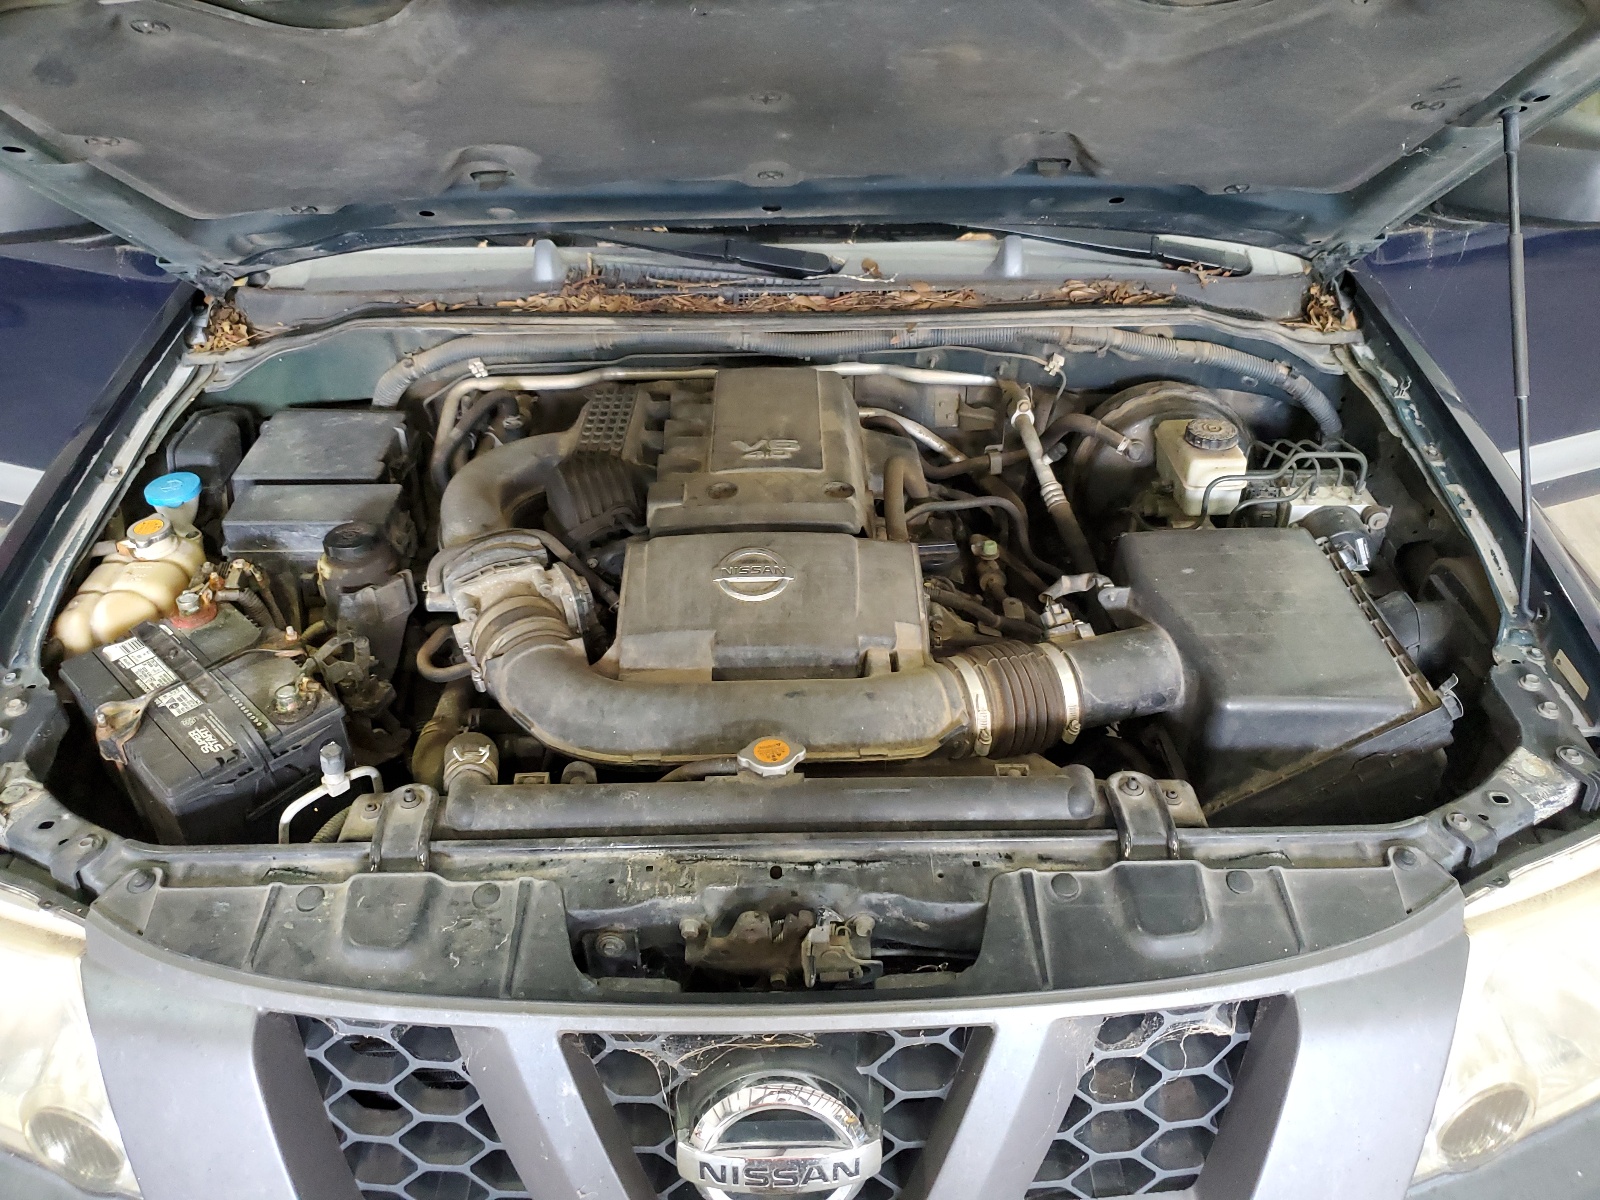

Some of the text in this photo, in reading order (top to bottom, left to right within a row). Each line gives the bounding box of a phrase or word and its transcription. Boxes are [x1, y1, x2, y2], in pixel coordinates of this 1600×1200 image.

[721, 565, 786, 575] NISSAN
[188, 728, 210, 754] SUPER
[195, 725, 225, 753] START
[699, 1157, 861, 1187] NISSAN
